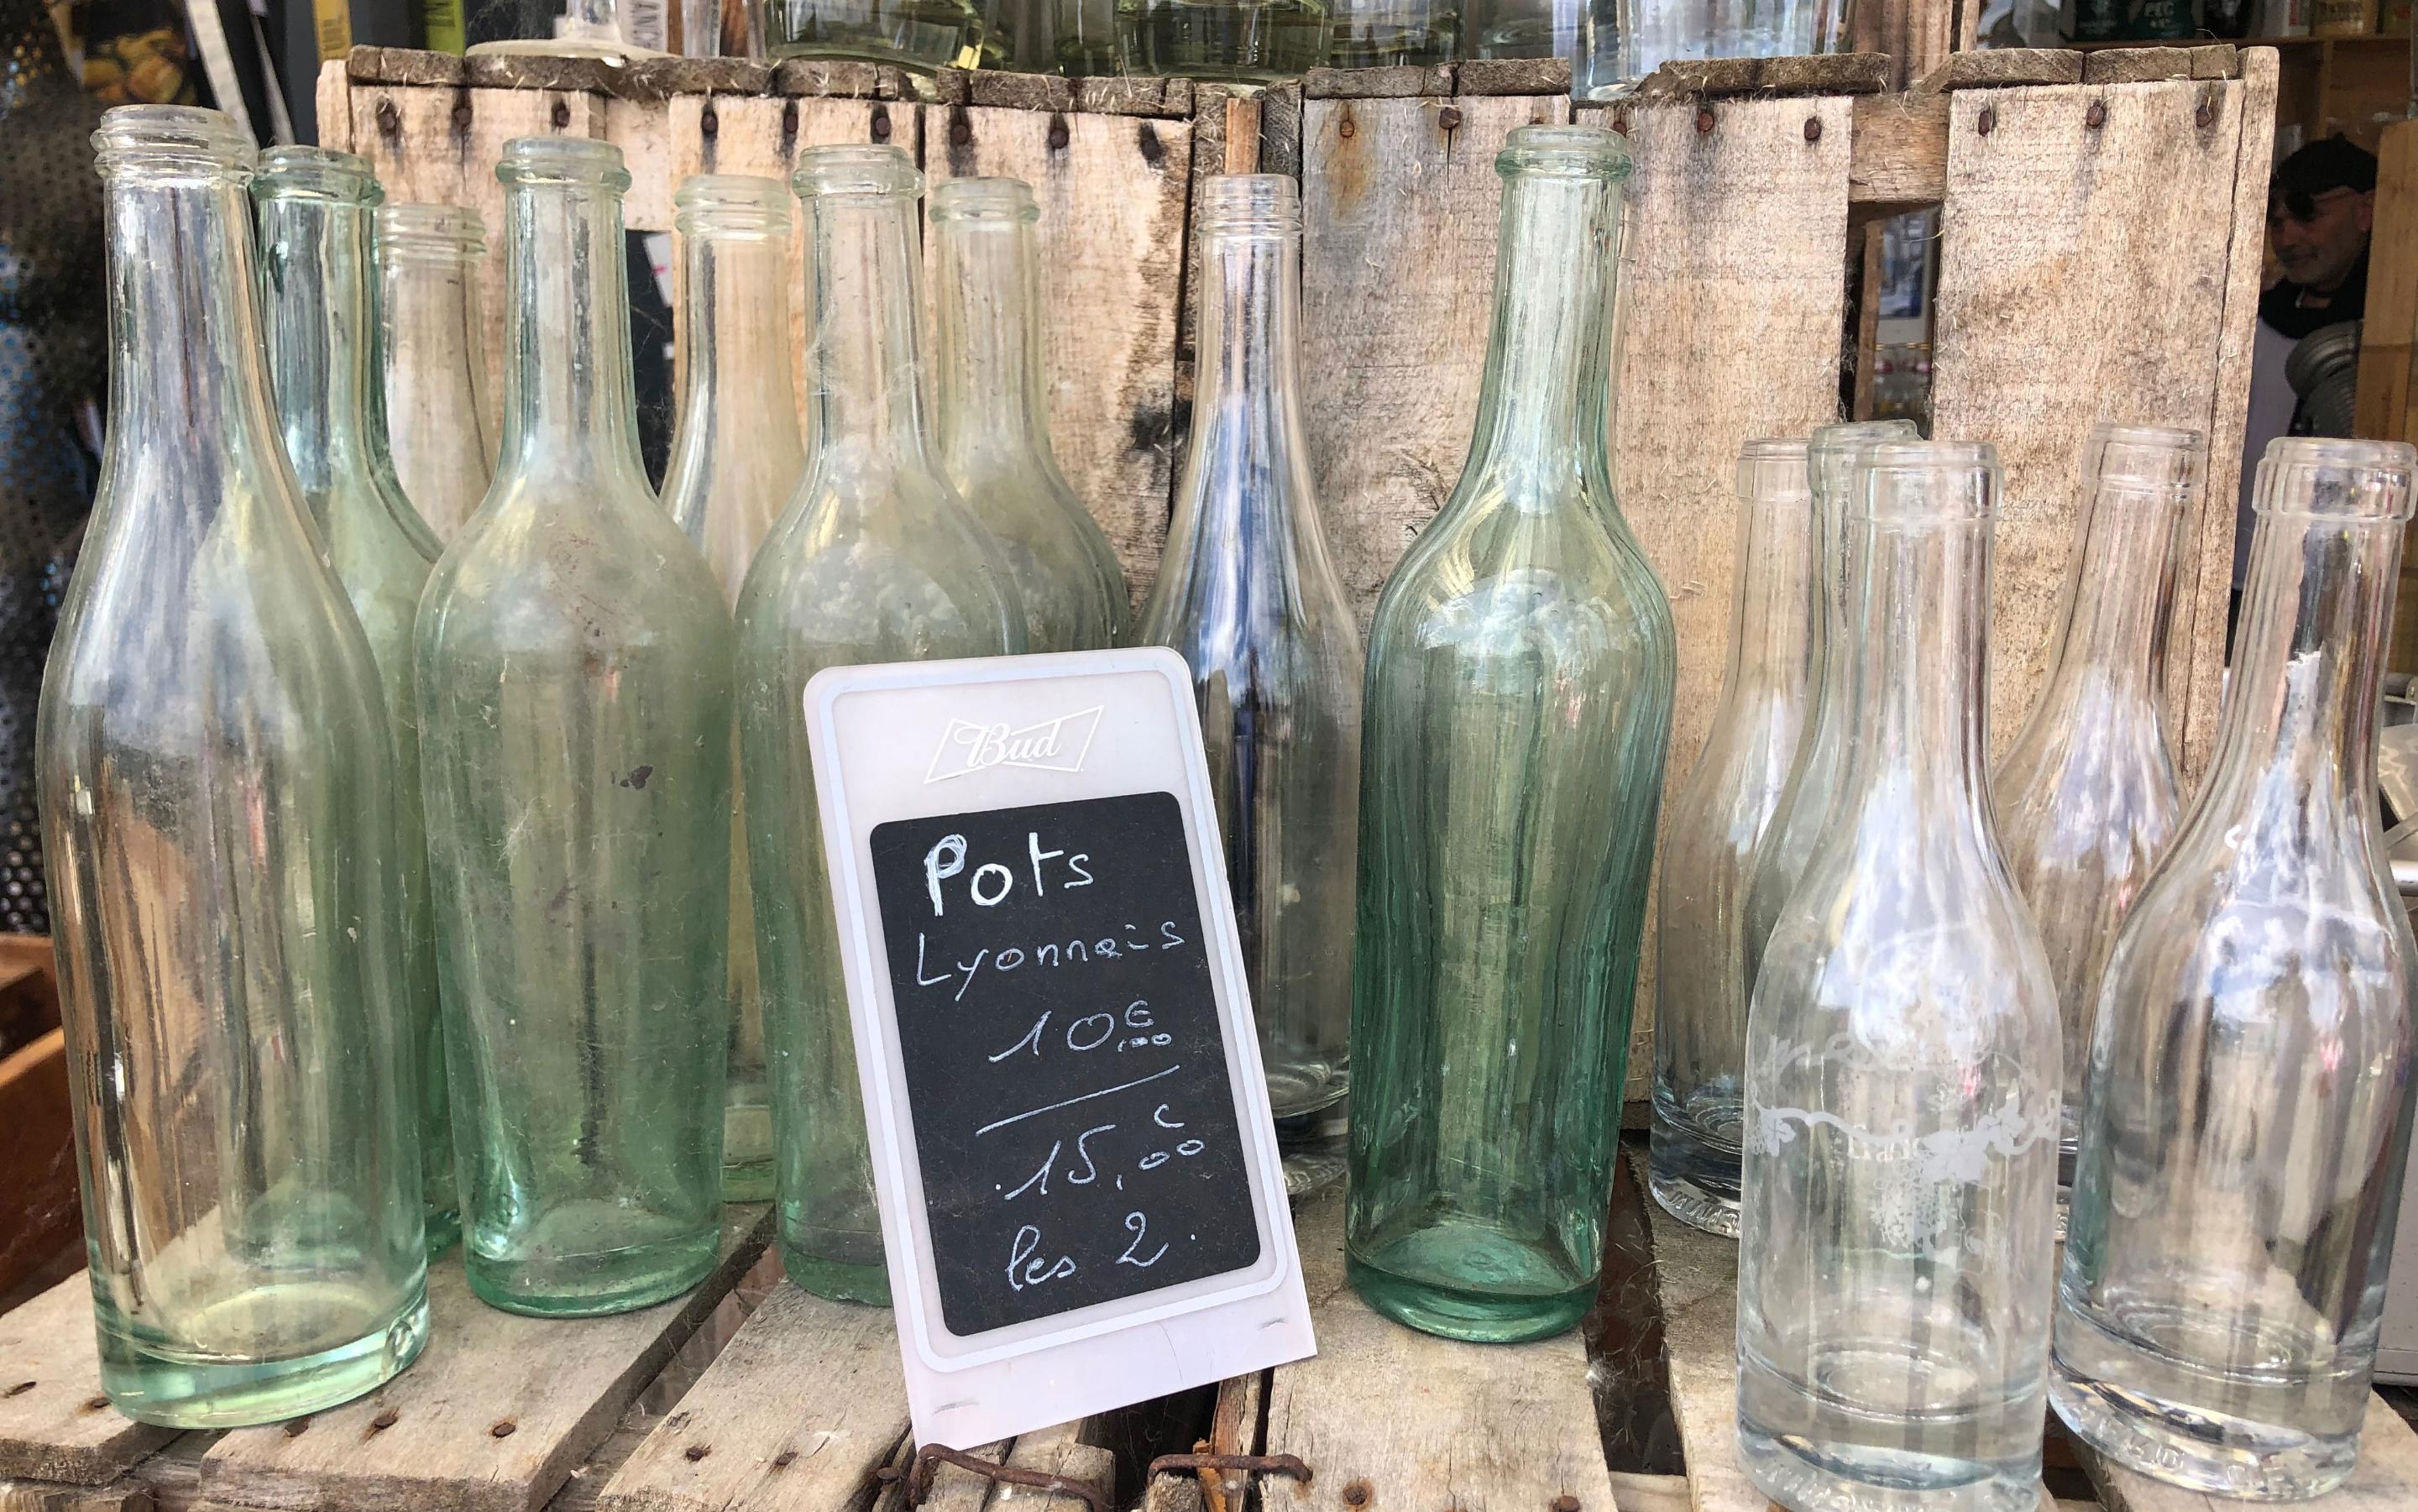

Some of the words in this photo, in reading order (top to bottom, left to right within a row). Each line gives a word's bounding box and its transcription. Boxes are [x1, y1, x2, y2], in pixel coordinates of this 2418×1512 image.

[953, 722, 1063, 767] Bud
[924, 832, 1094, 917] Pots
[916, 921, 1185, 1002] Lyonnais
[1005, 1224, 1077, 1291] les
